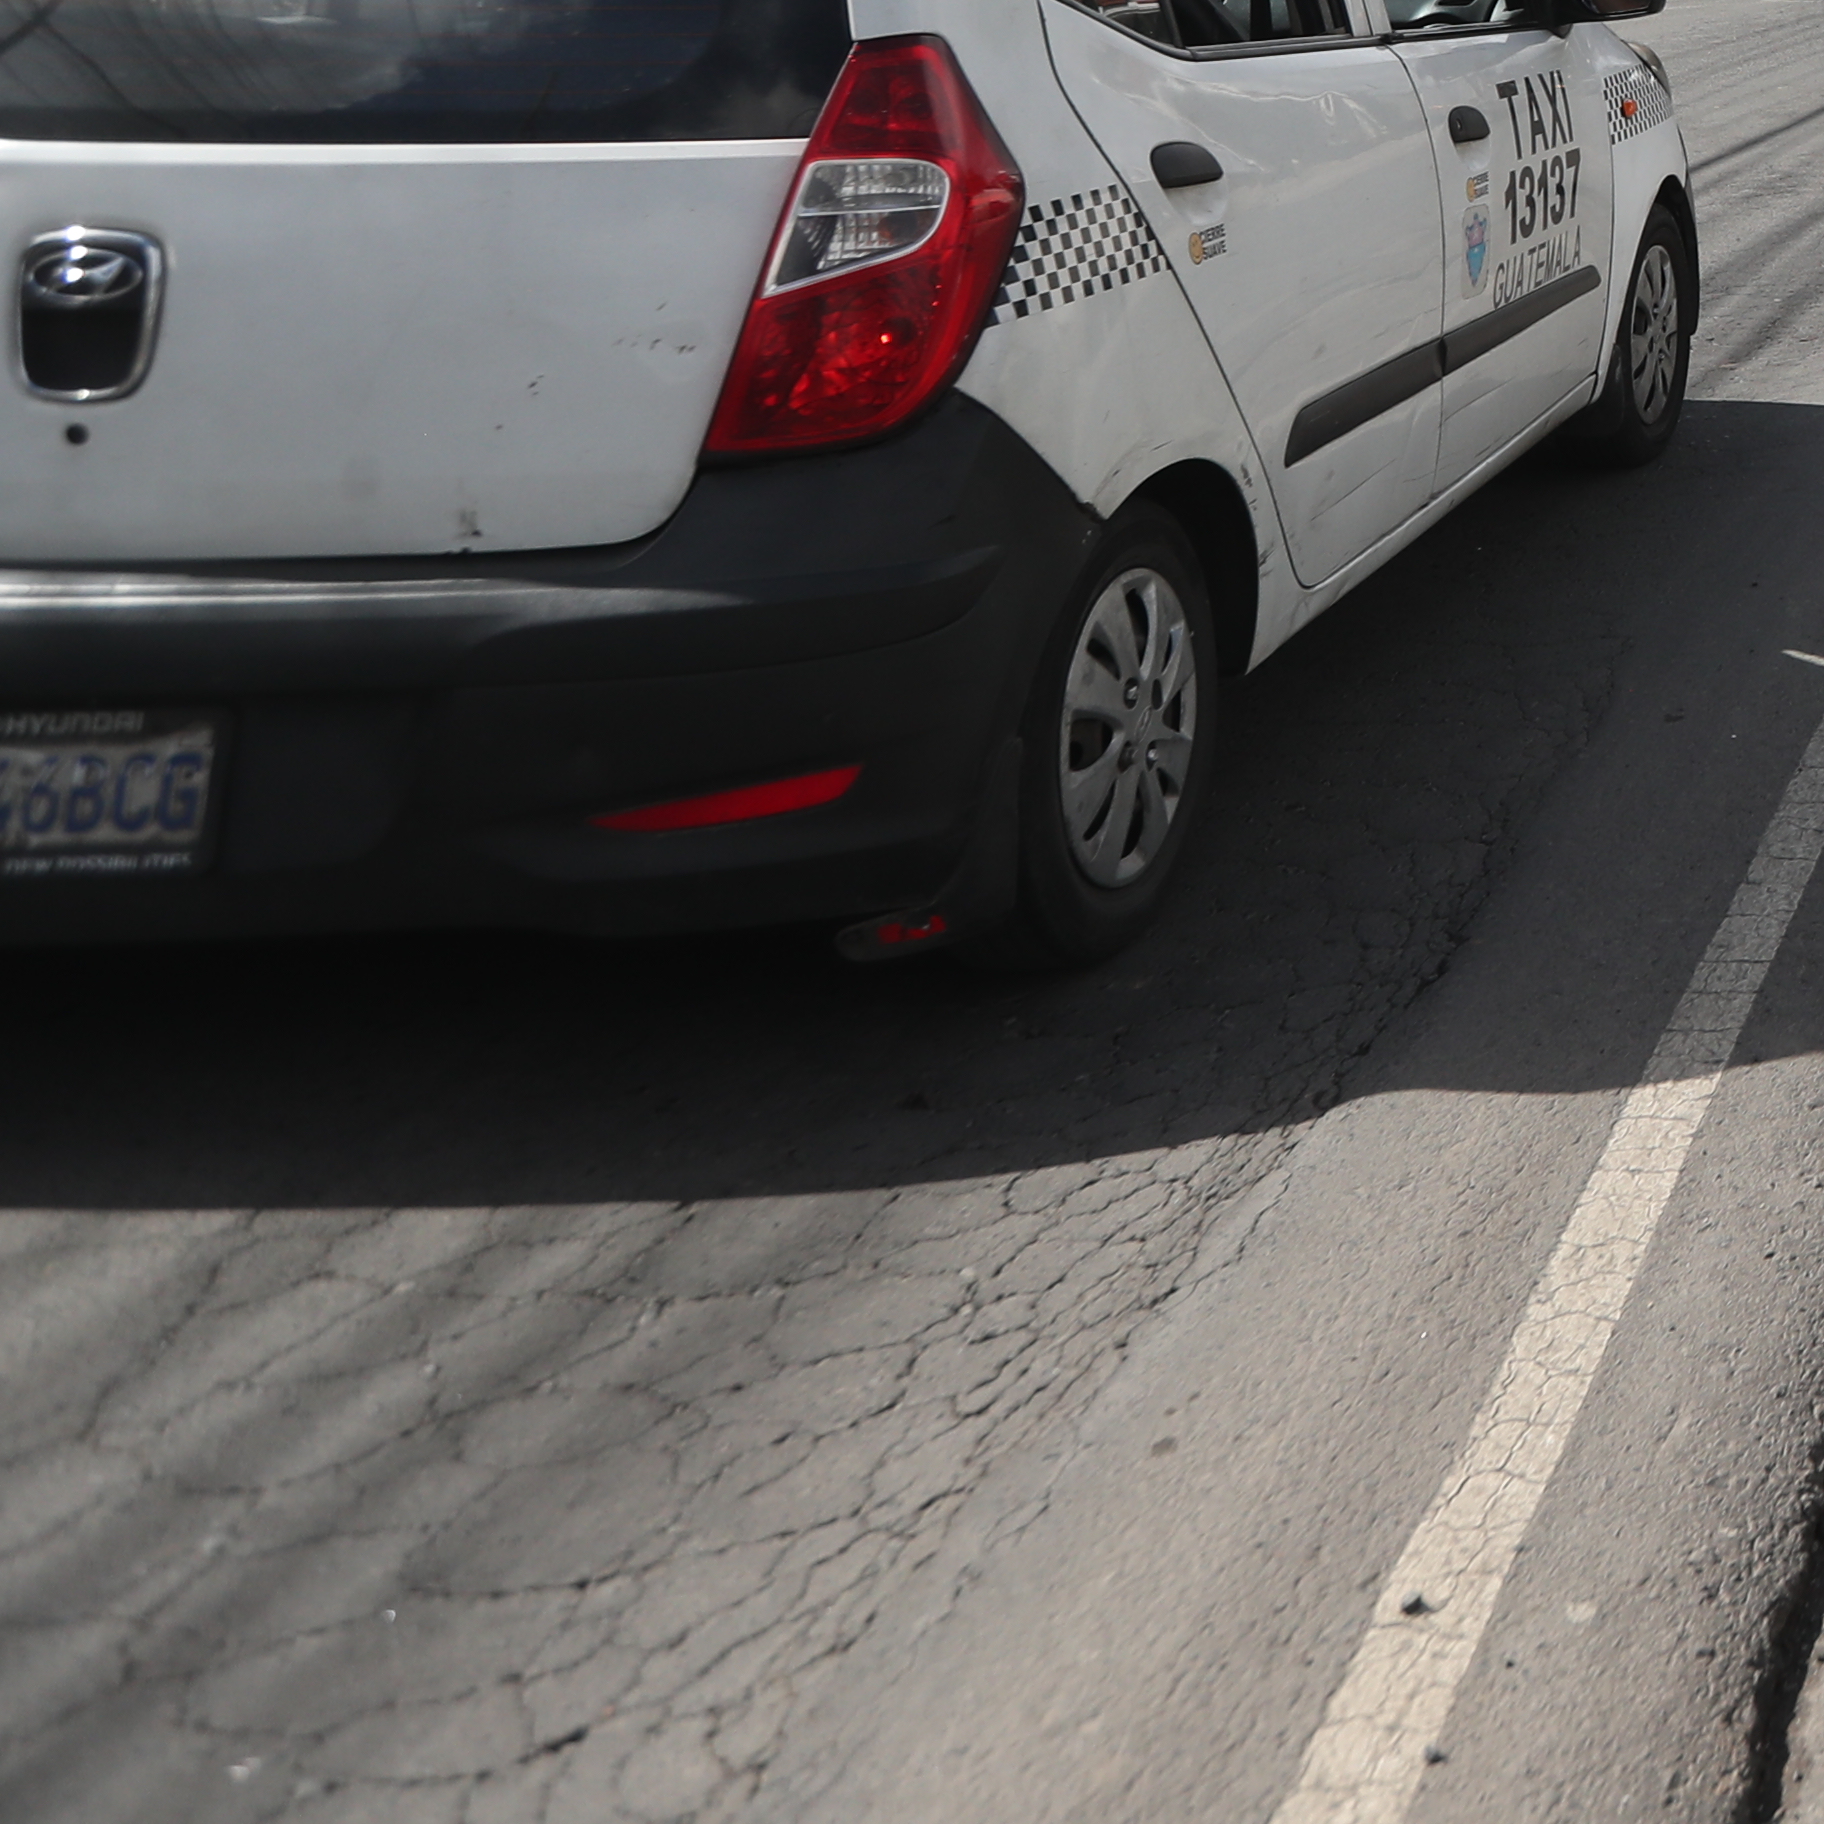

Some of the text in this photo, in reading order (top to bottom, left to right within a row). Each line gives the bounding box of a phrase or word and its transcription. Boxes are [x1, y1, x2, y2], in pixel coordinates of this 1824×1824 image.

[1496, 69, 1574, 161] TAXI
[1504, 147, 1581, 245] 13137
[1493, 224, 1581, 310] GUATEMALA
